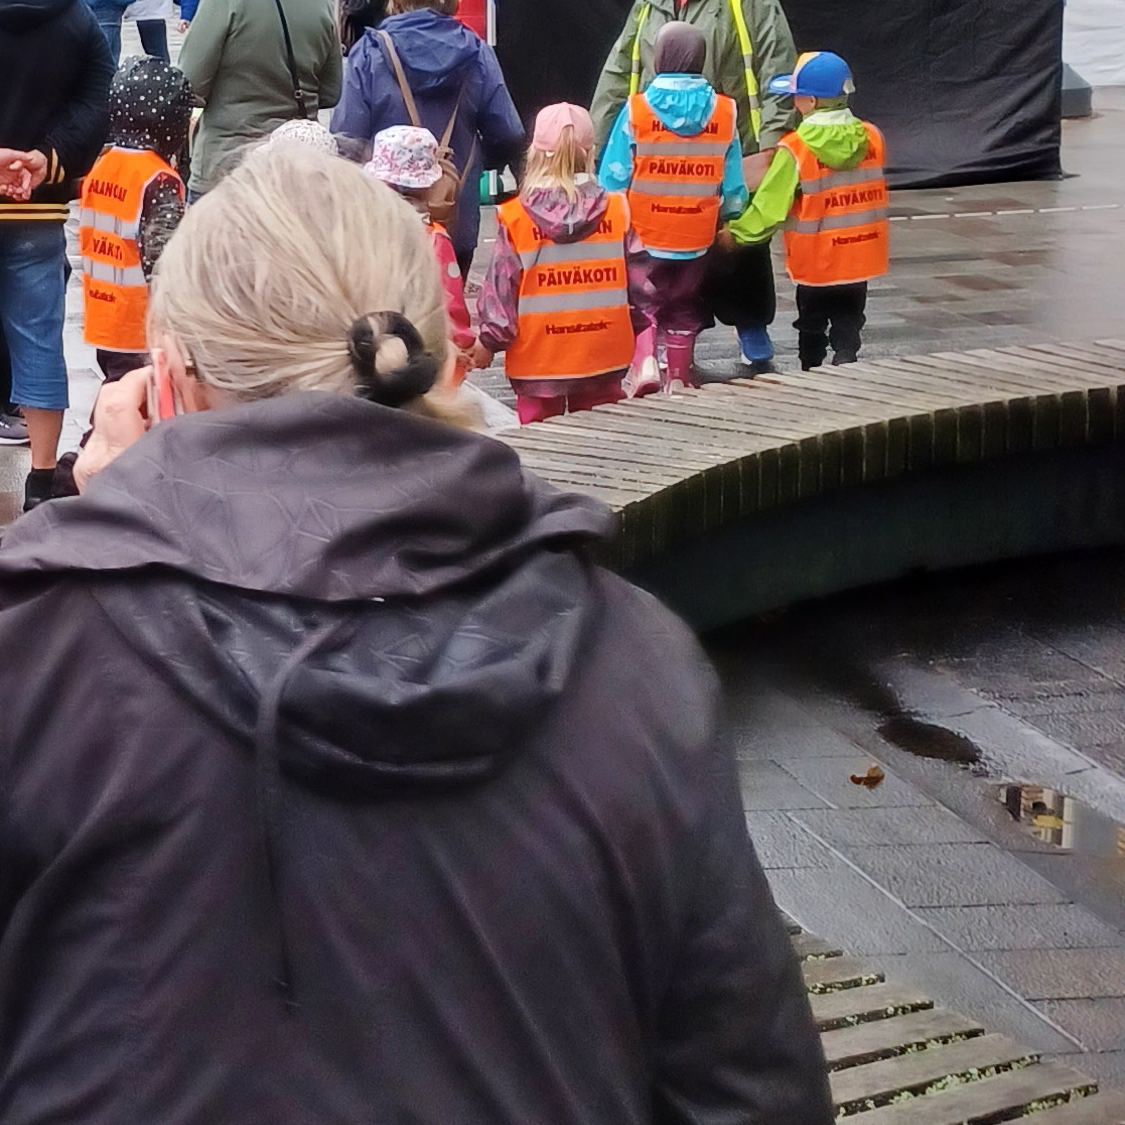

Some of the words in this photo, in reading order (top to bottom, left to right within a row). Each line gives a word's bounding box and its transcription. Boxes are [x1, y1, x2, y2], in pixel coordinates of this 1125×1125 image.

[649, 159, 715, 176] PÄIVÄKOTI
[825, 188, 883, 210] PÄIVÄKOTI
[538, 265, 617, 287] PÄIVÄKOTI
